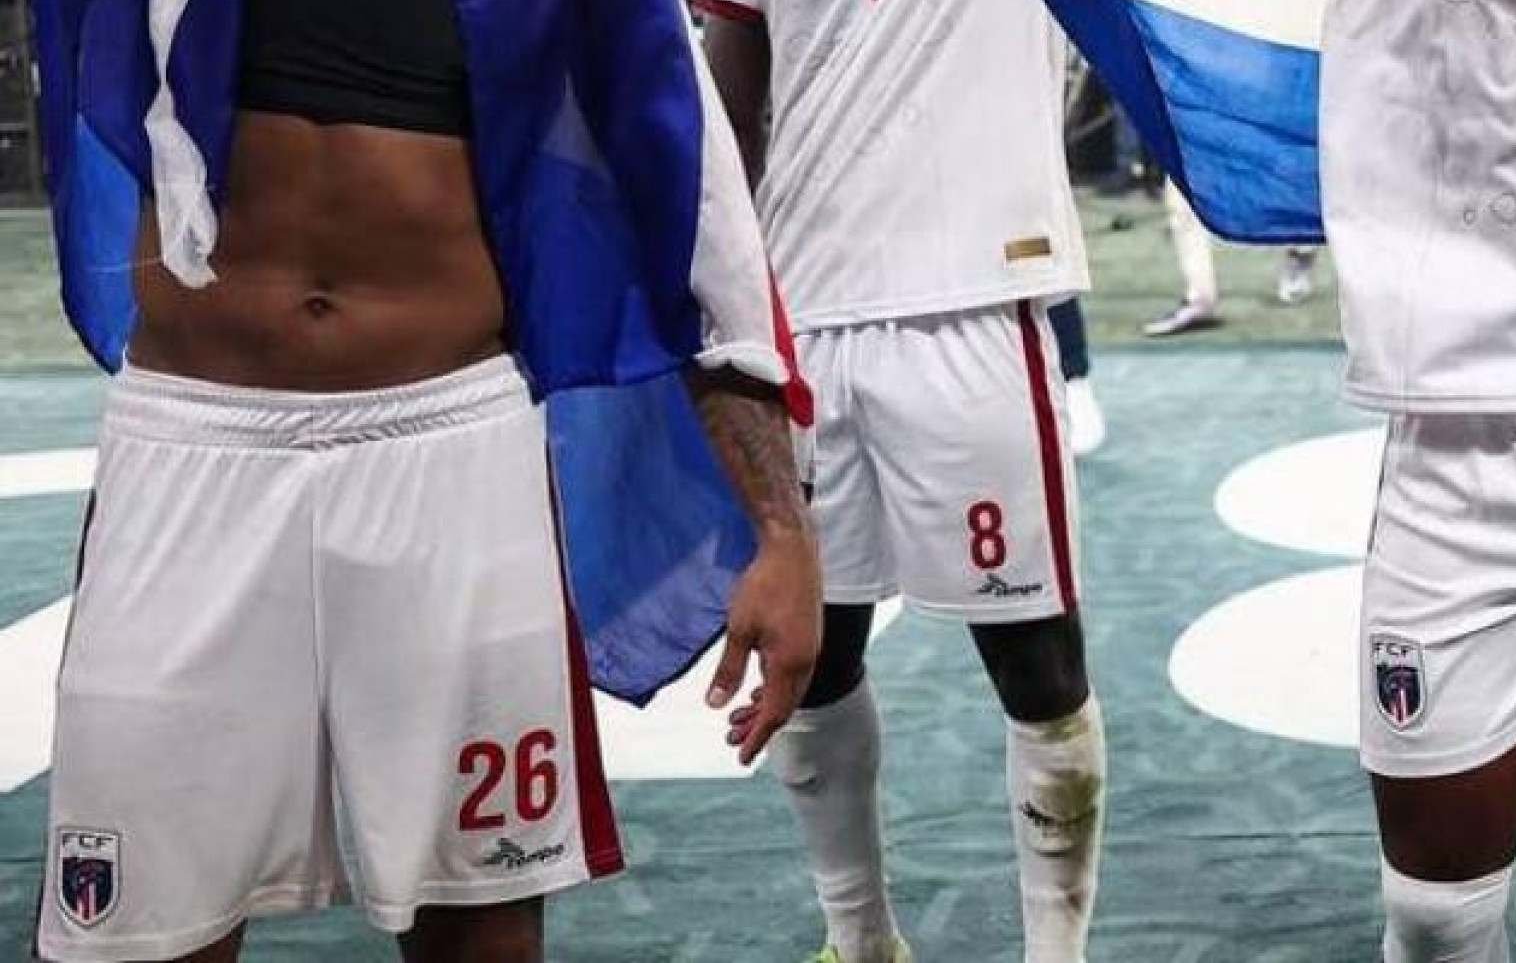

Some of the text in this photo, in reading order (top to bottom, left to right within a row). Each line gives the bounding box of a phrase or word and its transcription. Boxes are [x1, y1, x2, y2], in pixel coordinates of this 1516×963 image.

[967, 500, 1006, 569] 8
[459, 729, 558, 831] 26
[62, 832, 114, 848] FCF
